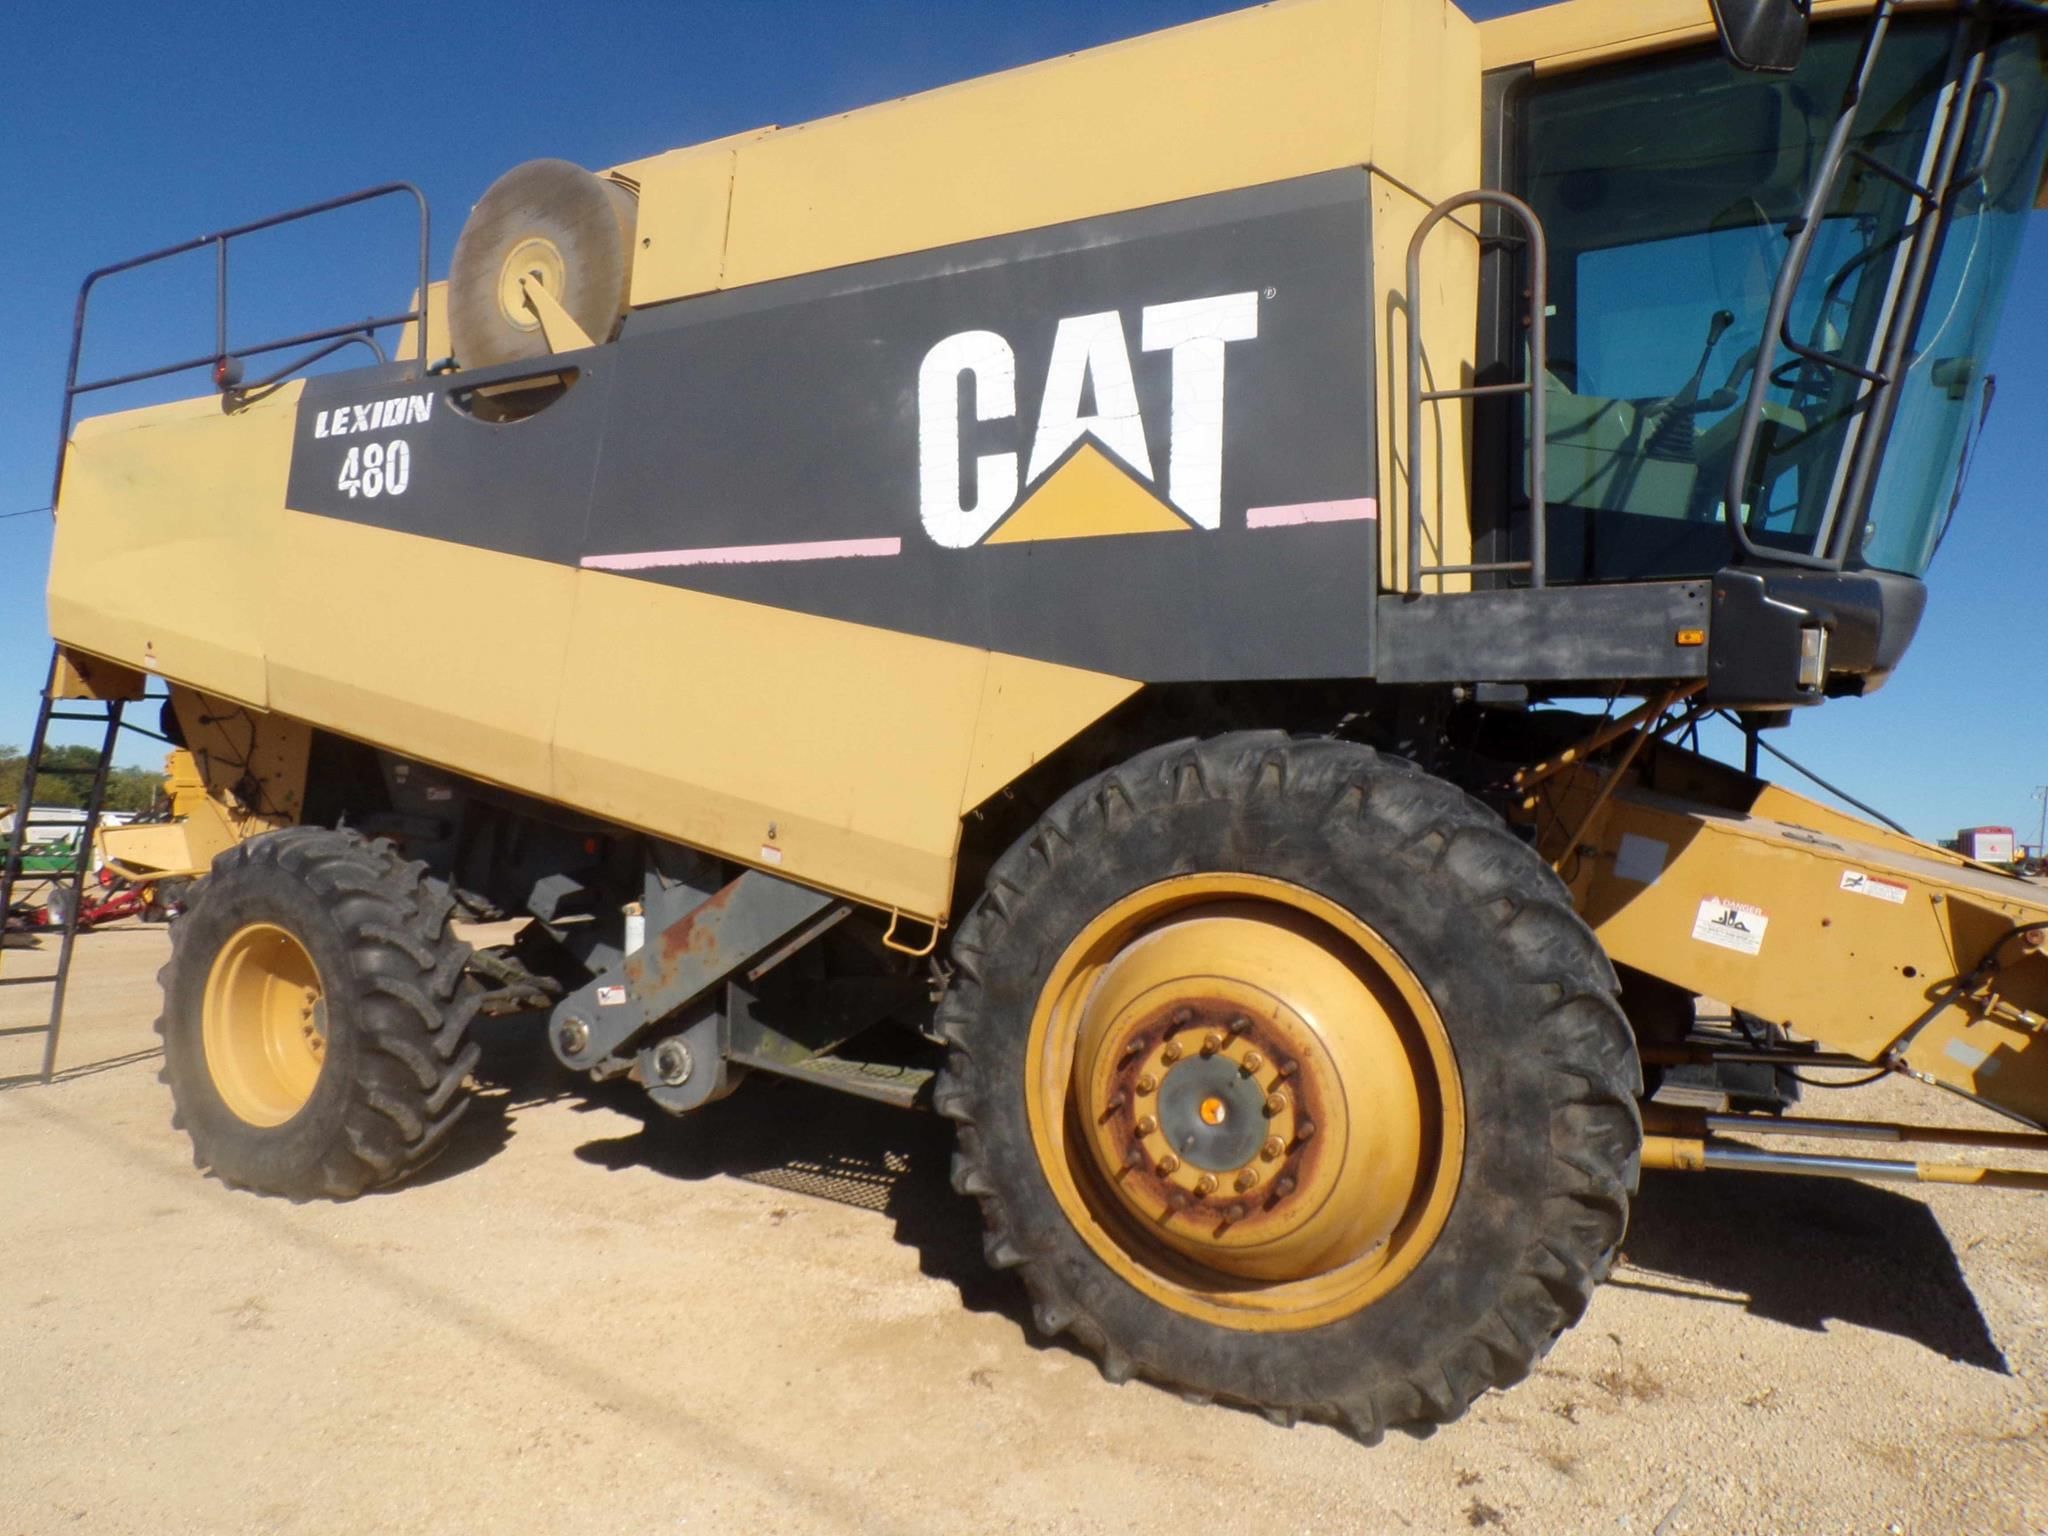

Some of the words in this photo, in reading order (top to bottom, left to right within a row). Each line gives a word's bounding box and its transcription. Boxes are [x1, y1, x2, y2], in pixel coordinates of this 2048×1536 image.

[314, 392, 434, 439] LEXION
[918, 290, 1259, 550] CAT
[337, 439, 410, 499] 480
